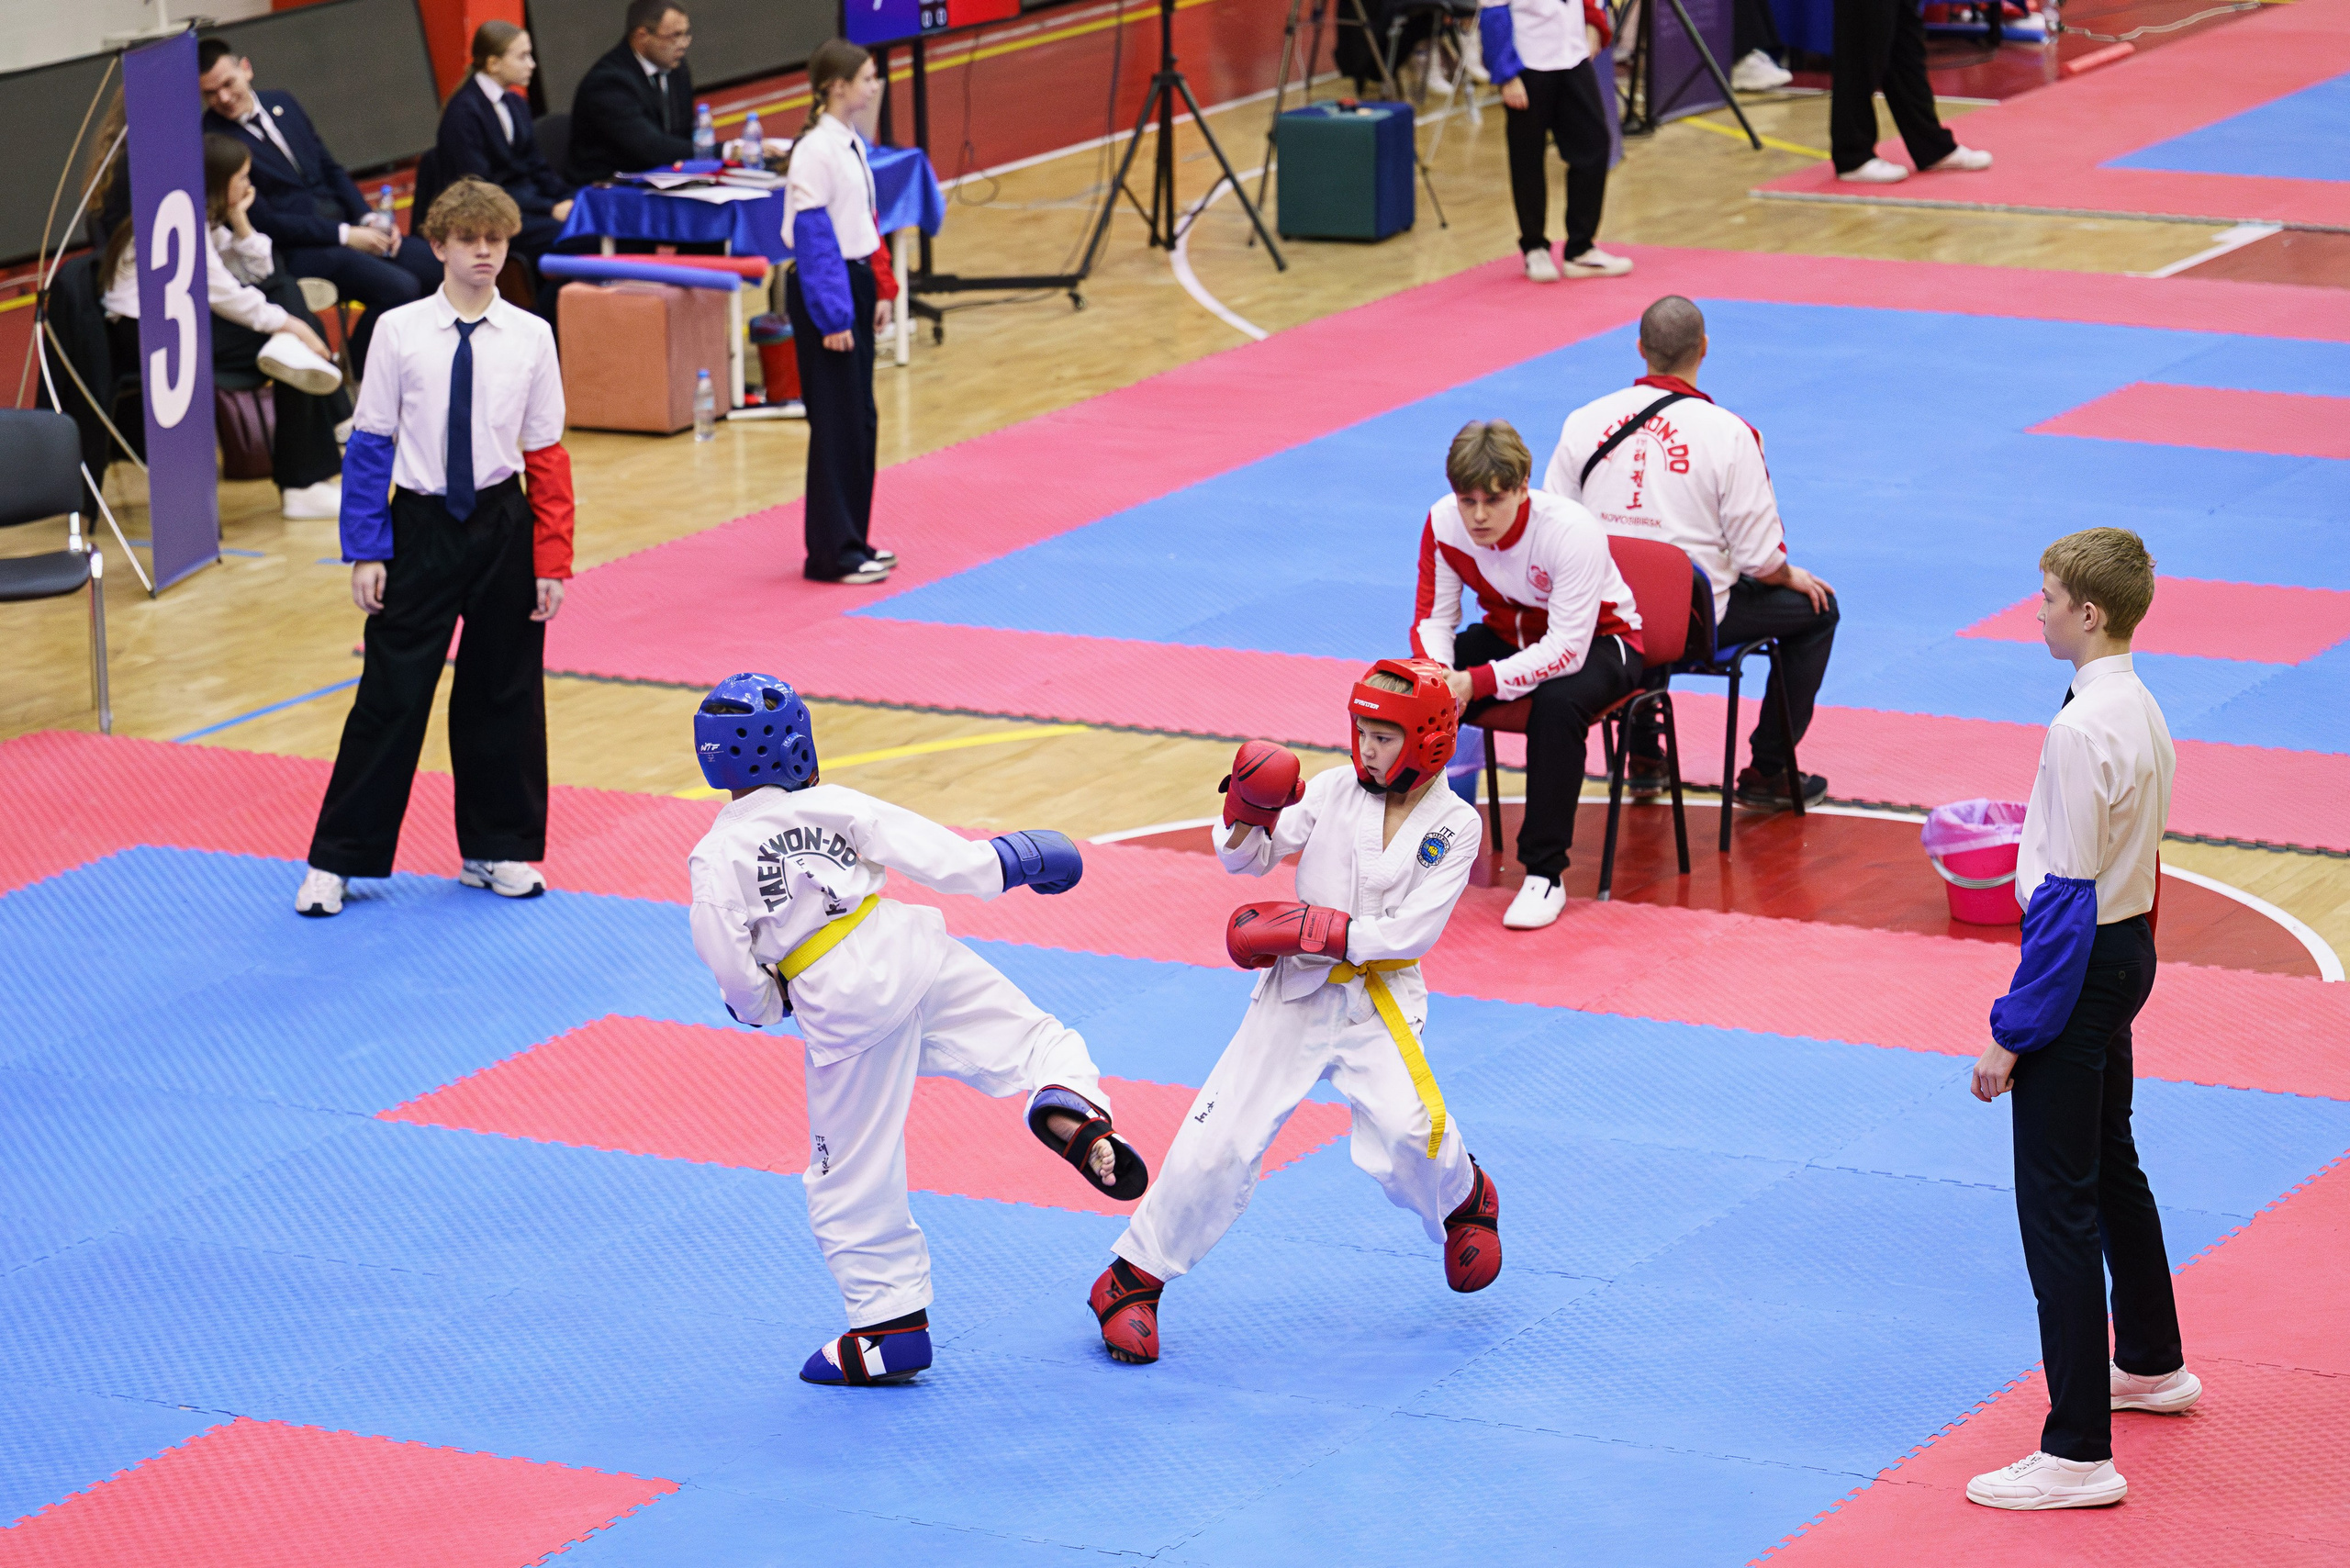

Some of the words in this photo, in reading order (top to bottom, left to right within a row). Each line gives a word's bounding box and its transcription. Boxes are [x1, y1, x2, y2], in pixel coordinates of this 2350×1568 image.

[150, 189, 197, 429] 3
[757, 826, 857, 913] TAEKWON-DO
[1438, 825, 1456, 838] ITF
